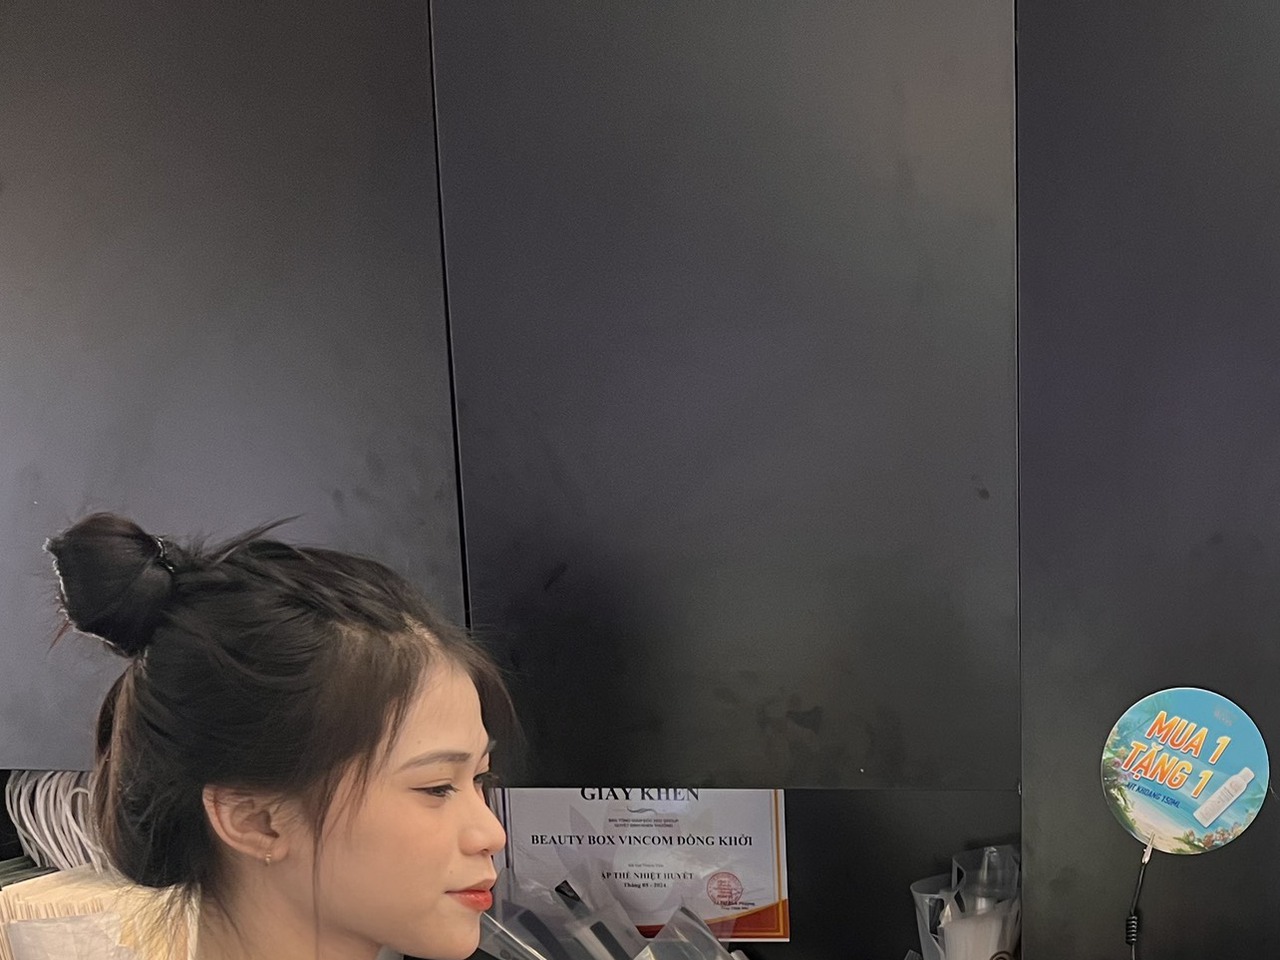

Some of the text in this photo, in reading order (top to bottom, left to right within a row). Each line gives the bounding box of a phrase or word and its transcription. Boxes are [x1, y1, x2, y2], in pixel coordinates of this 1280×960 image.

[1145, 711, 1208, 757] MUA
[1208, 735, 1231, 765] 1
[1121, 741, 1214, 798] TẶNG 1
[531, 834, 584, 845] BEAUTY
[588, 835, 615, 845] BOX
[618, 835, 673, 846] VINCOM
